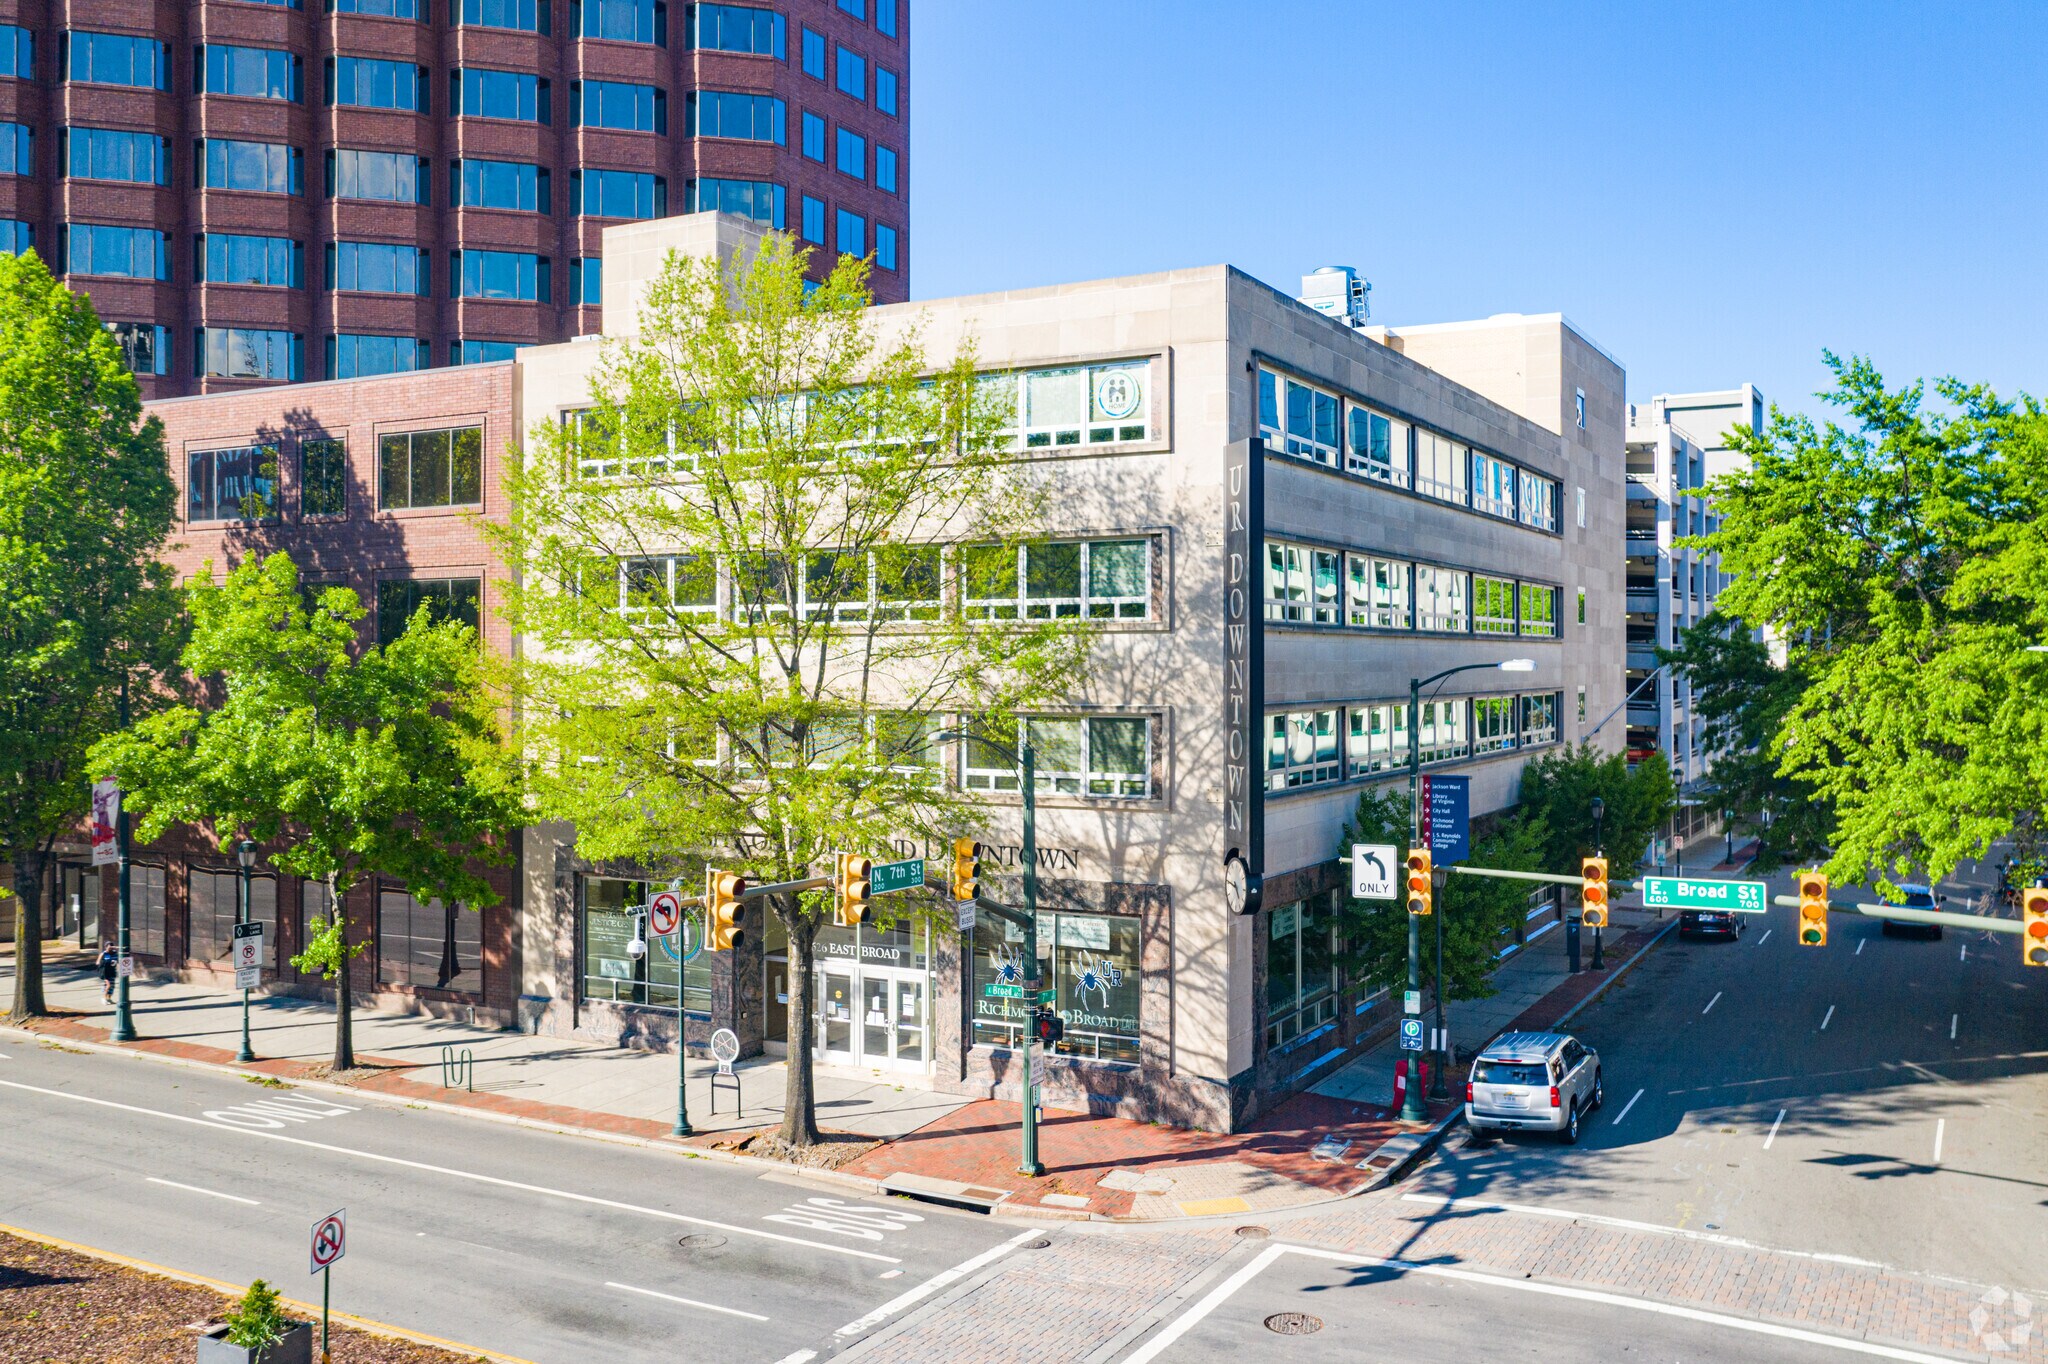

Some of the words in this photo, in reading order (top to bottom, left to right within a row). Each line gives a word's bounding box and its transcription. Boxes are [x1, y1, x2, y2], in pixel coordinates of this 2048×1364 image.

[1229, 464, 1245, 532] UR
[1227, 553, 1245, 832] DOWNTOWN
[874, 870, 884, 882] N.
[890, 866, 906, 880] 7th
[910, 864, 920, 876] St
[1360, 883, 1389, 893] ONLY
[1650, 881, 1667, 895] E.
[1678, 882, 1727, 898] Broad
[1738, 885, 1757, 900] St
[829, 943, 856, 955] EAST
[861, 946, 900, 959] BROAD
[992, 986, 1012, 995] Broad
[1073, 1009, 1119, 1027] BROAD
[202, 1092, 362, 1128] ONLY
[761, 1198, 926, 1241] BUS
